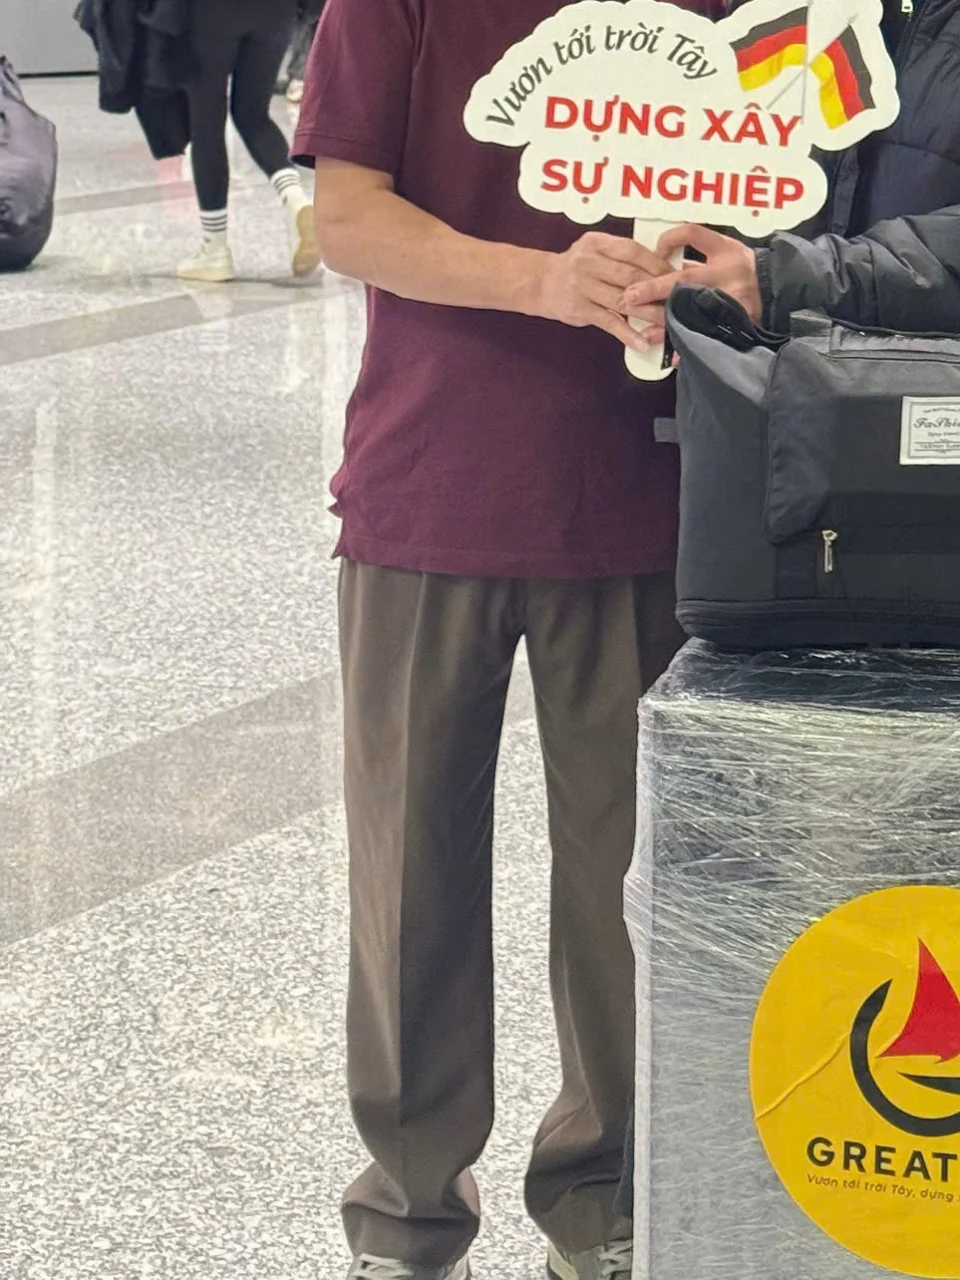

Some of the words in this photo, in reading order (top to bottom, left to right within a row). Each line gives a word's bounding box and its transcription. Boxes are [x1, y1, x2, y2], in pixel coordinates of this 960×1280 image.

[486, 56, 554, 129] Vươn
[553, 23, 598, 67] tới
[604, 21, 665, 53] trời
[666, 33, 718, 81] Tây
[545, 94, 686, 142] DỰNG
[701, 103, 802, 148] XÂY
[540, 156, 609, 205] SỰ
[620, 163, 805, 218] NGHIỆP
